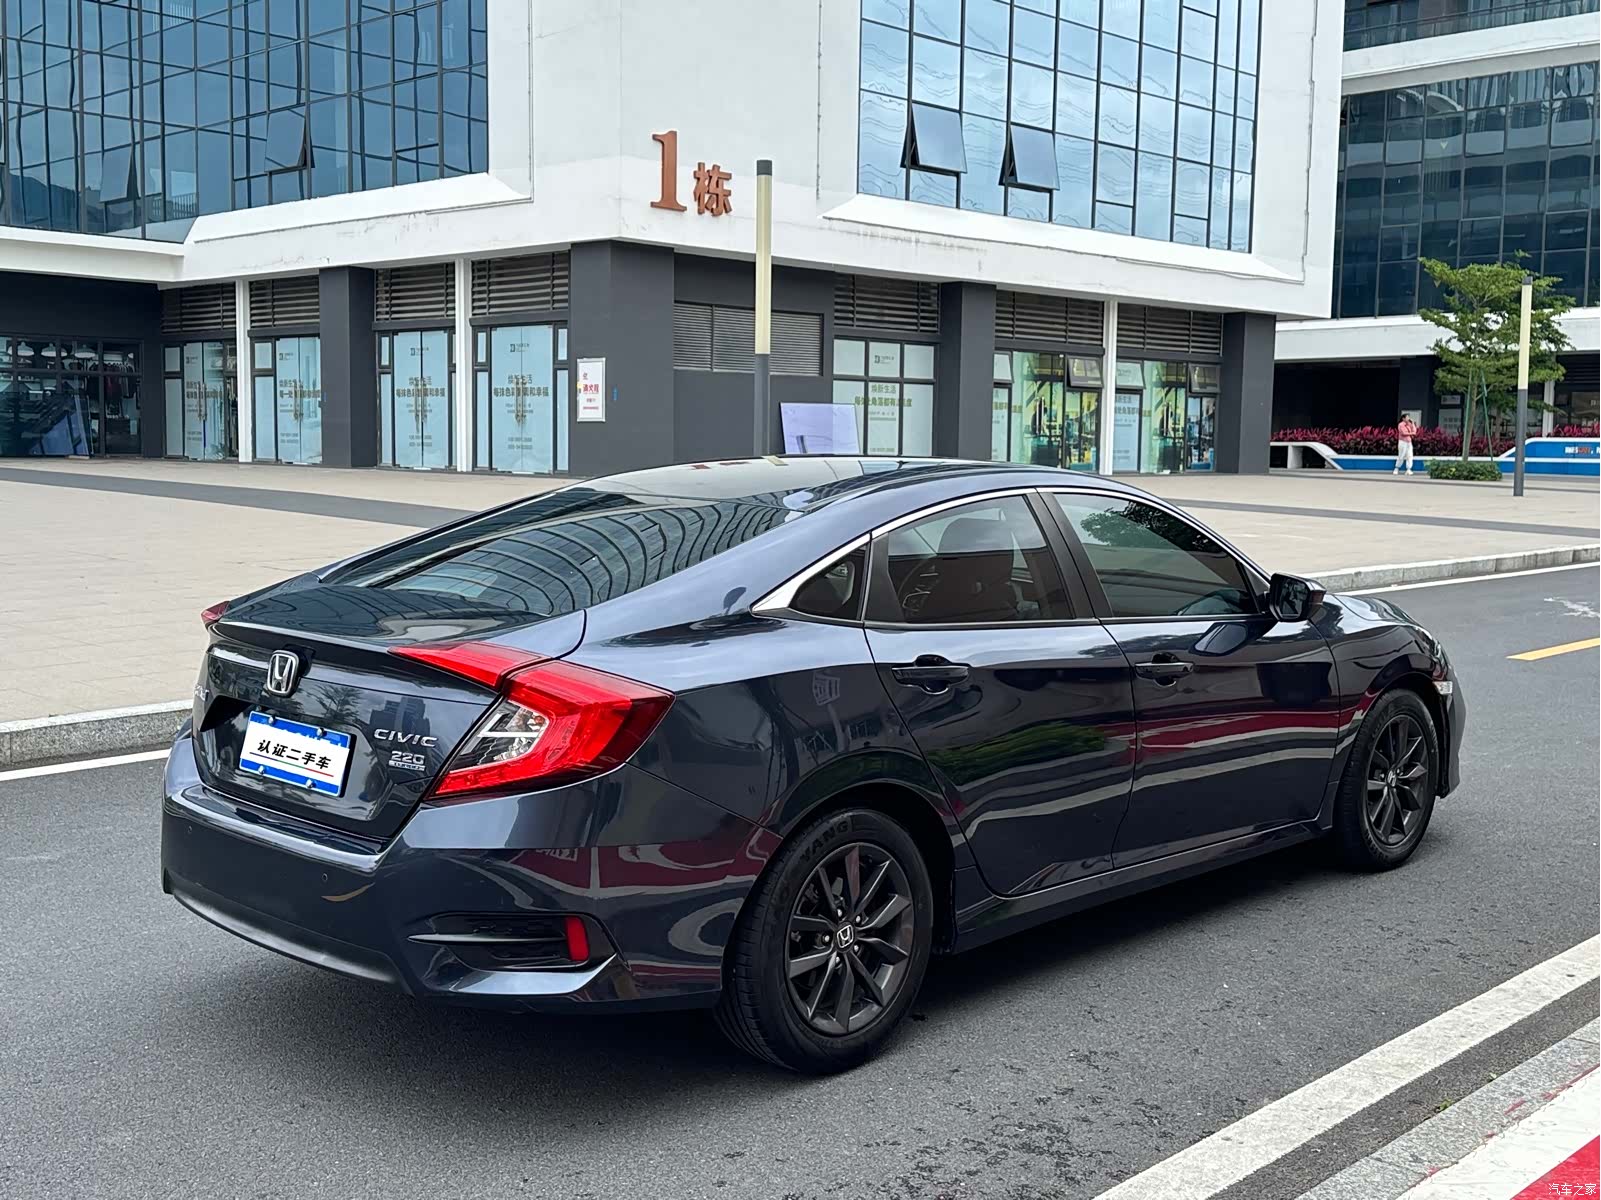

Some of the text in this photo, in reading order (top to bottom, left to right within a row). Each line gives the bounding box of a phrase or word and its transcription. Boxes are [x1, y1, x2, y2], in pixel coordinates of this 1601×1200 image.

[650, 130, 733, 216] 1栋
[373, 728, 439, 747] CIVIC
[391, 750, 425, 765] 220
